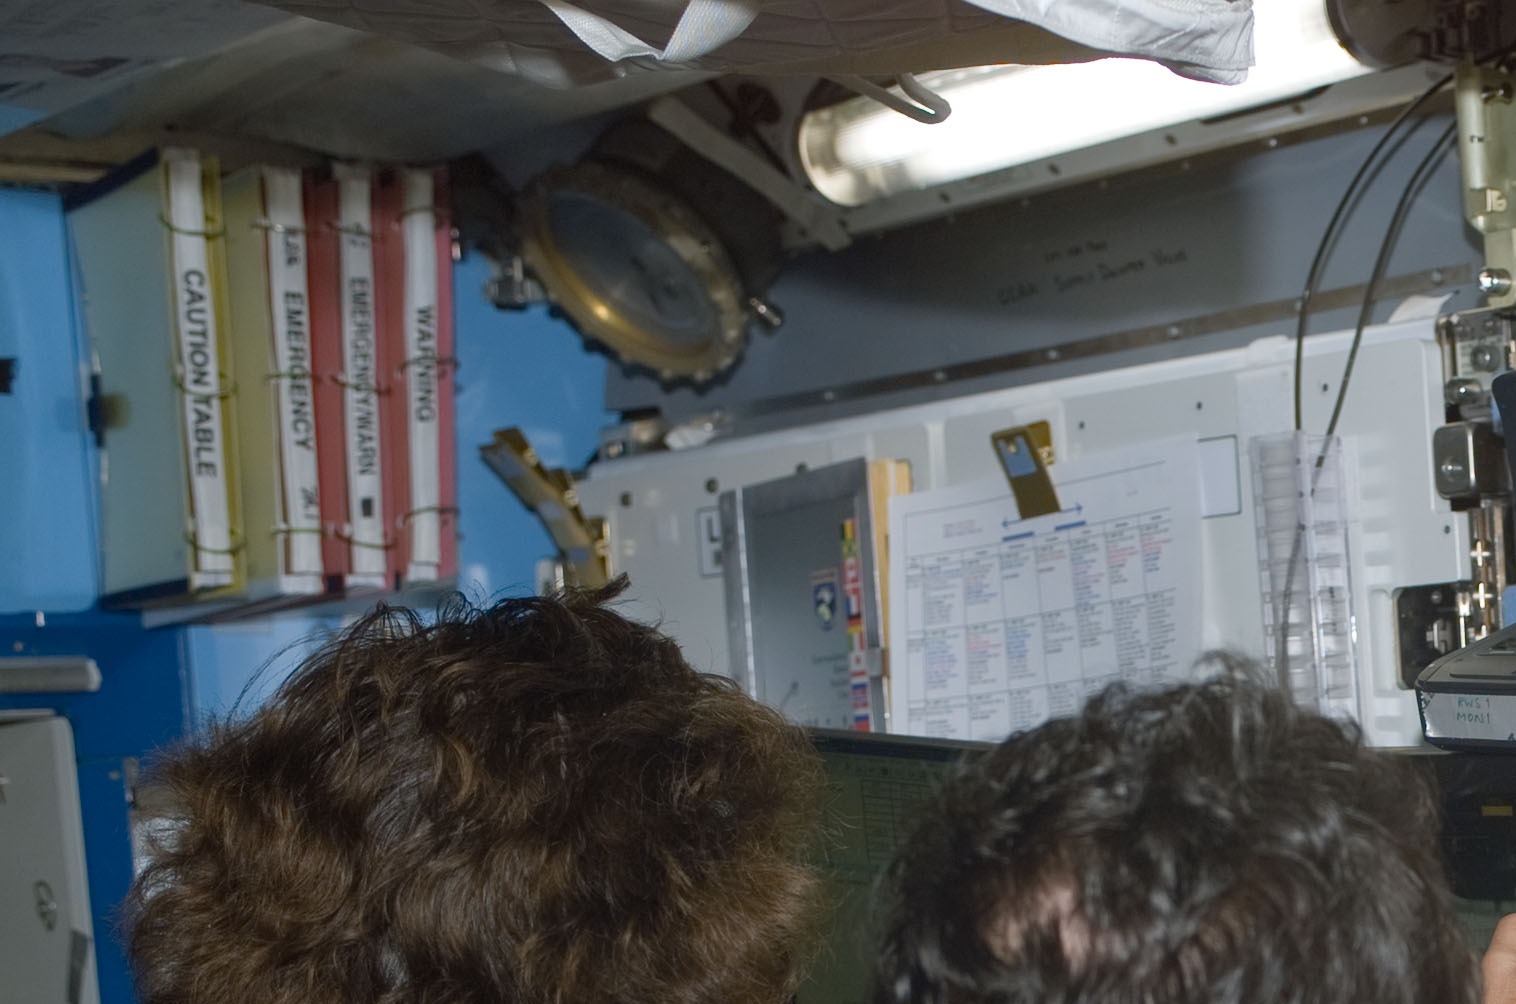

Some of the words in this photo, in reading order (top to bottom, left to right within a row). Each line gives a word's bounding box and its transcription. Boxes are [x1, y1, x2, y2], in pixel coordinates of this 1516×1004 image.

[183, 269, 215, 386] CAUTION
[283, 290, 313, 451] EMERGENCY
[414, 304, 437, 424] WARNING
[192, 394, 218, 478] TABLE
